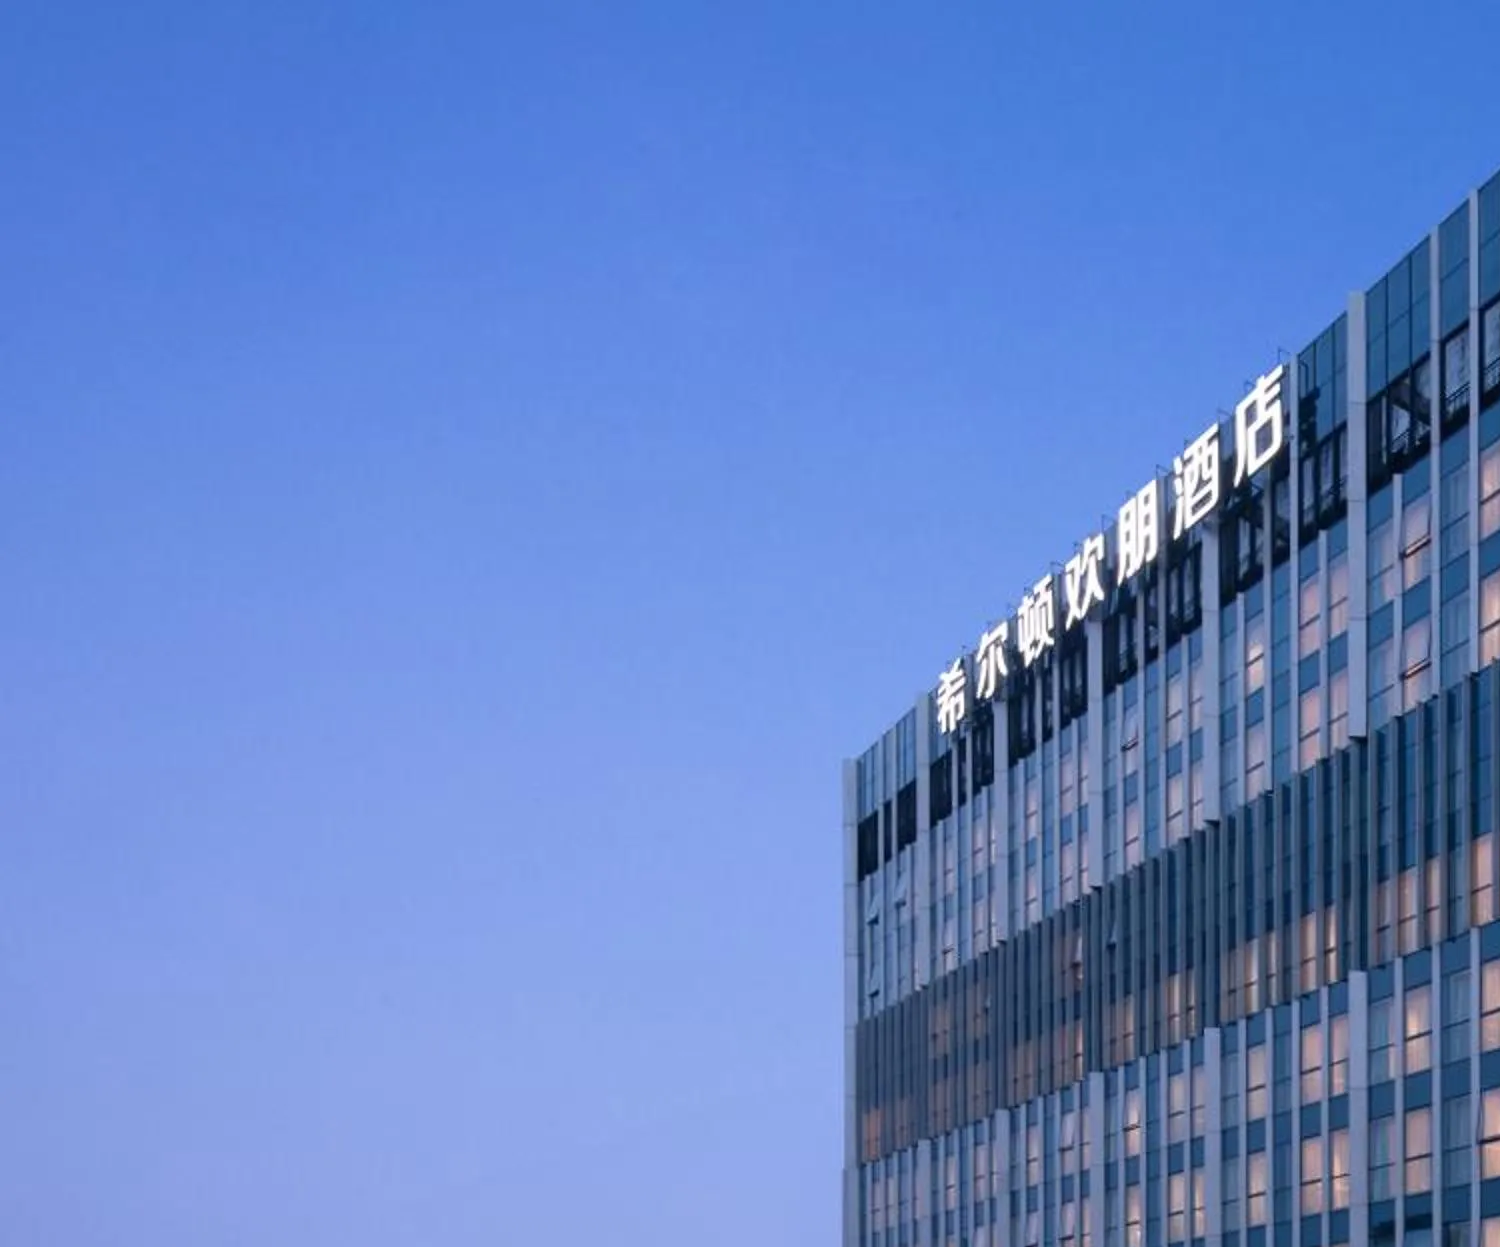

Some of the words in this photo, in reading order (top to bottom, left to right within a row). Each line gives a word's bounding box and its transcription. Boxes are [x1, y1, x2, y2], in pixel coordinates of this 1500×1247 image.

[936, 364, 1284, 735] 希尔顿欢朋酒店
